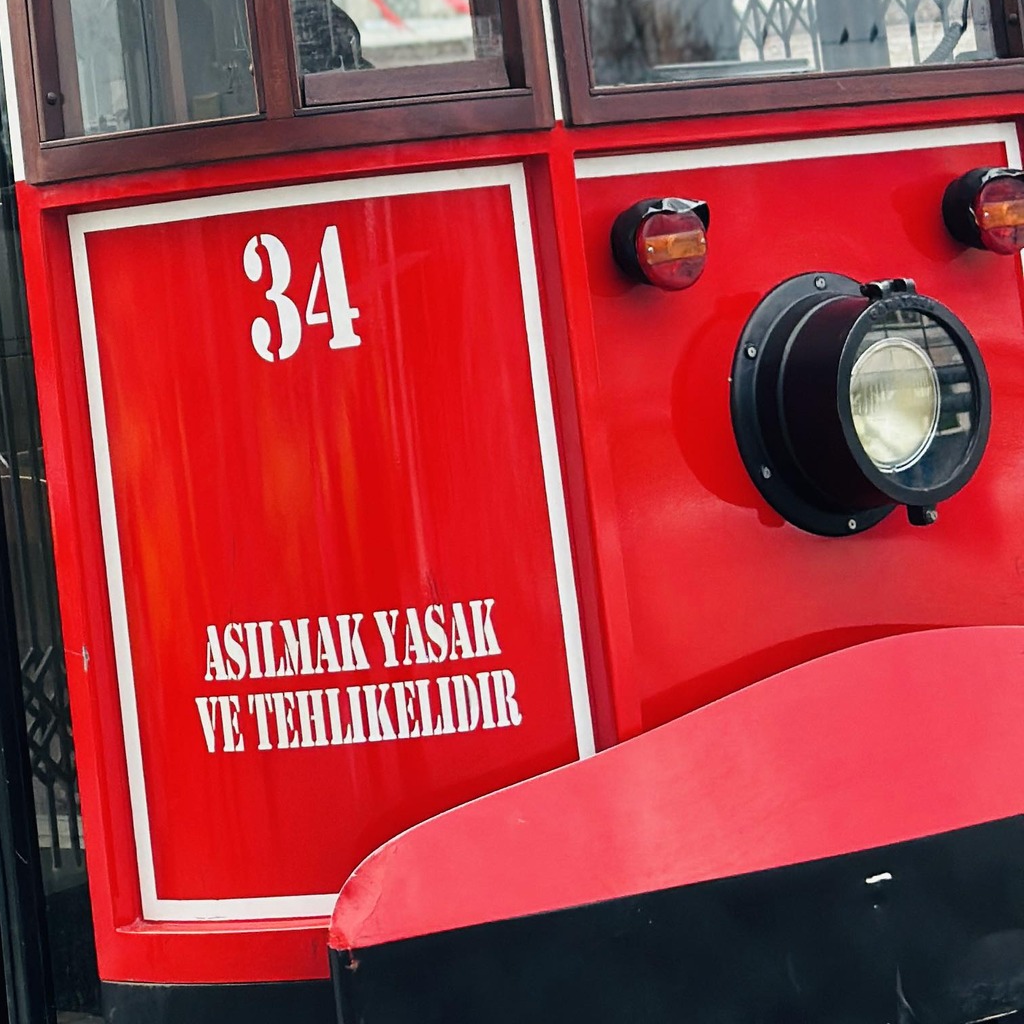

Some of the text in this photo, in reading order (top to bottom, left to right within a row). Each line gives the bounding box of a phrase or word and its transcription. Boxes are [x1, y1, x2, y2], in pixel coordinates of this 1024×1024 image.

[243, 225, 362, 363] 34
[204, 598, 502, 681] ASILMAK YASAK
[195, 669, 523, 753] VE TEHLIKELIDIR
